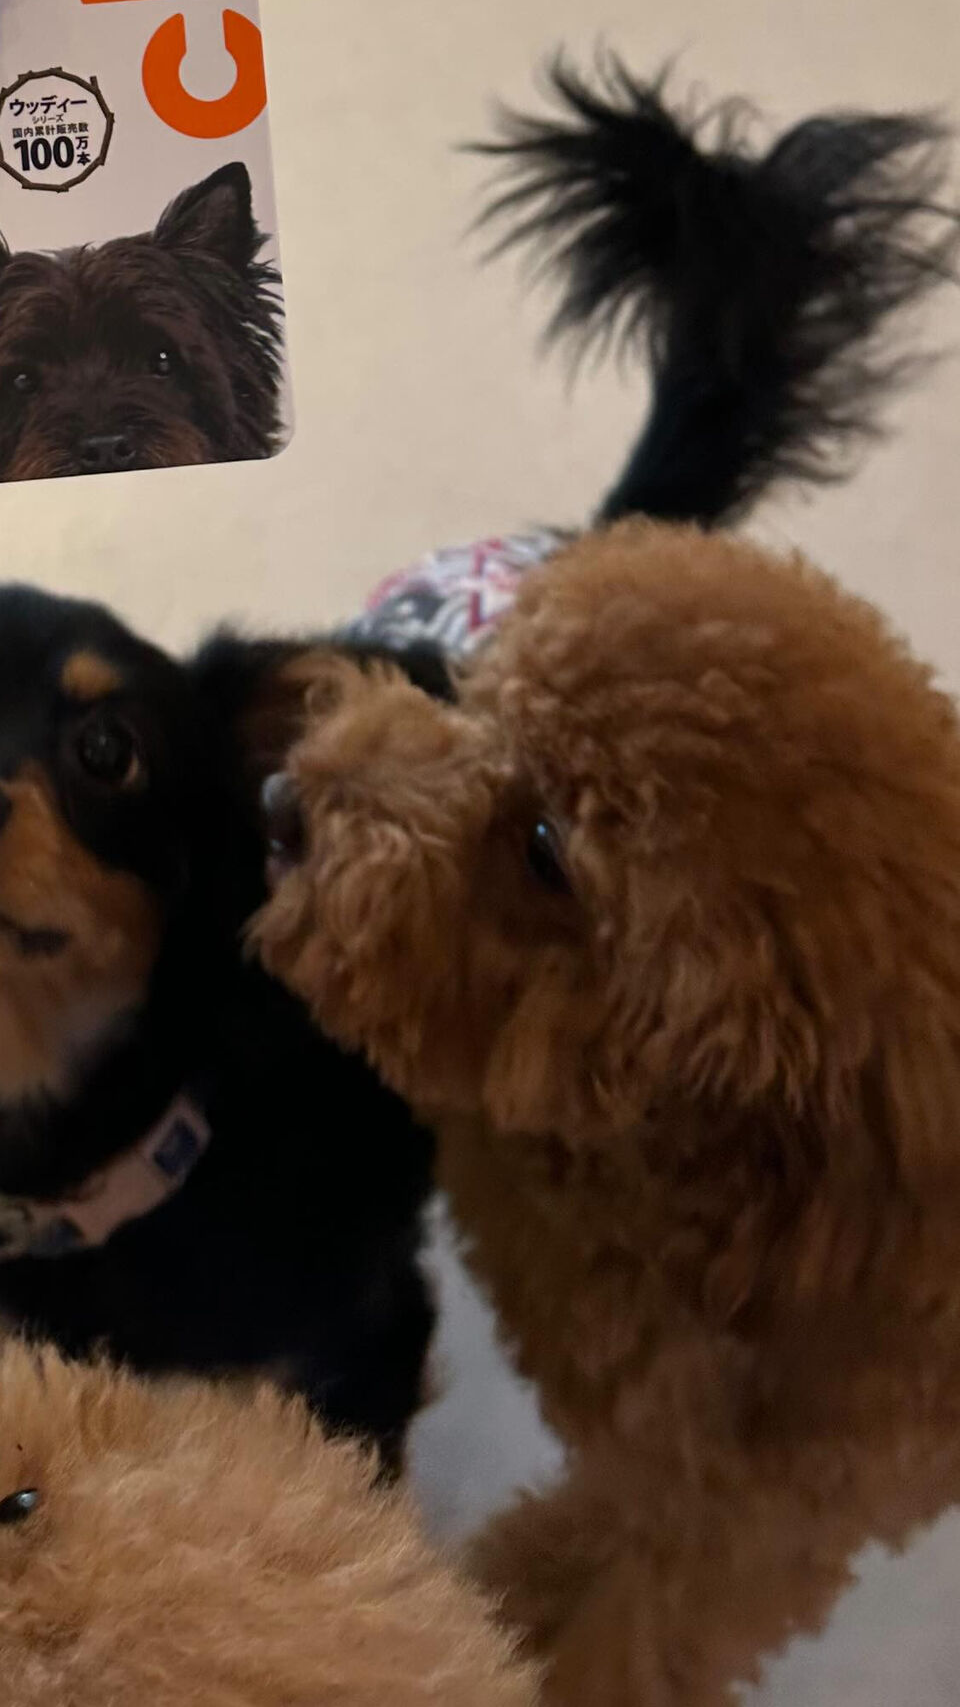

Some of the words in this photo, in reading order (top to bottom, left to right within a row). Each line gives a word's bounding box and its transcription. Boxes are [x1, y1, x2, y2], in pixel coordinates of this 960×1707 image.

[9, 95, 87, 116] ウッディー
